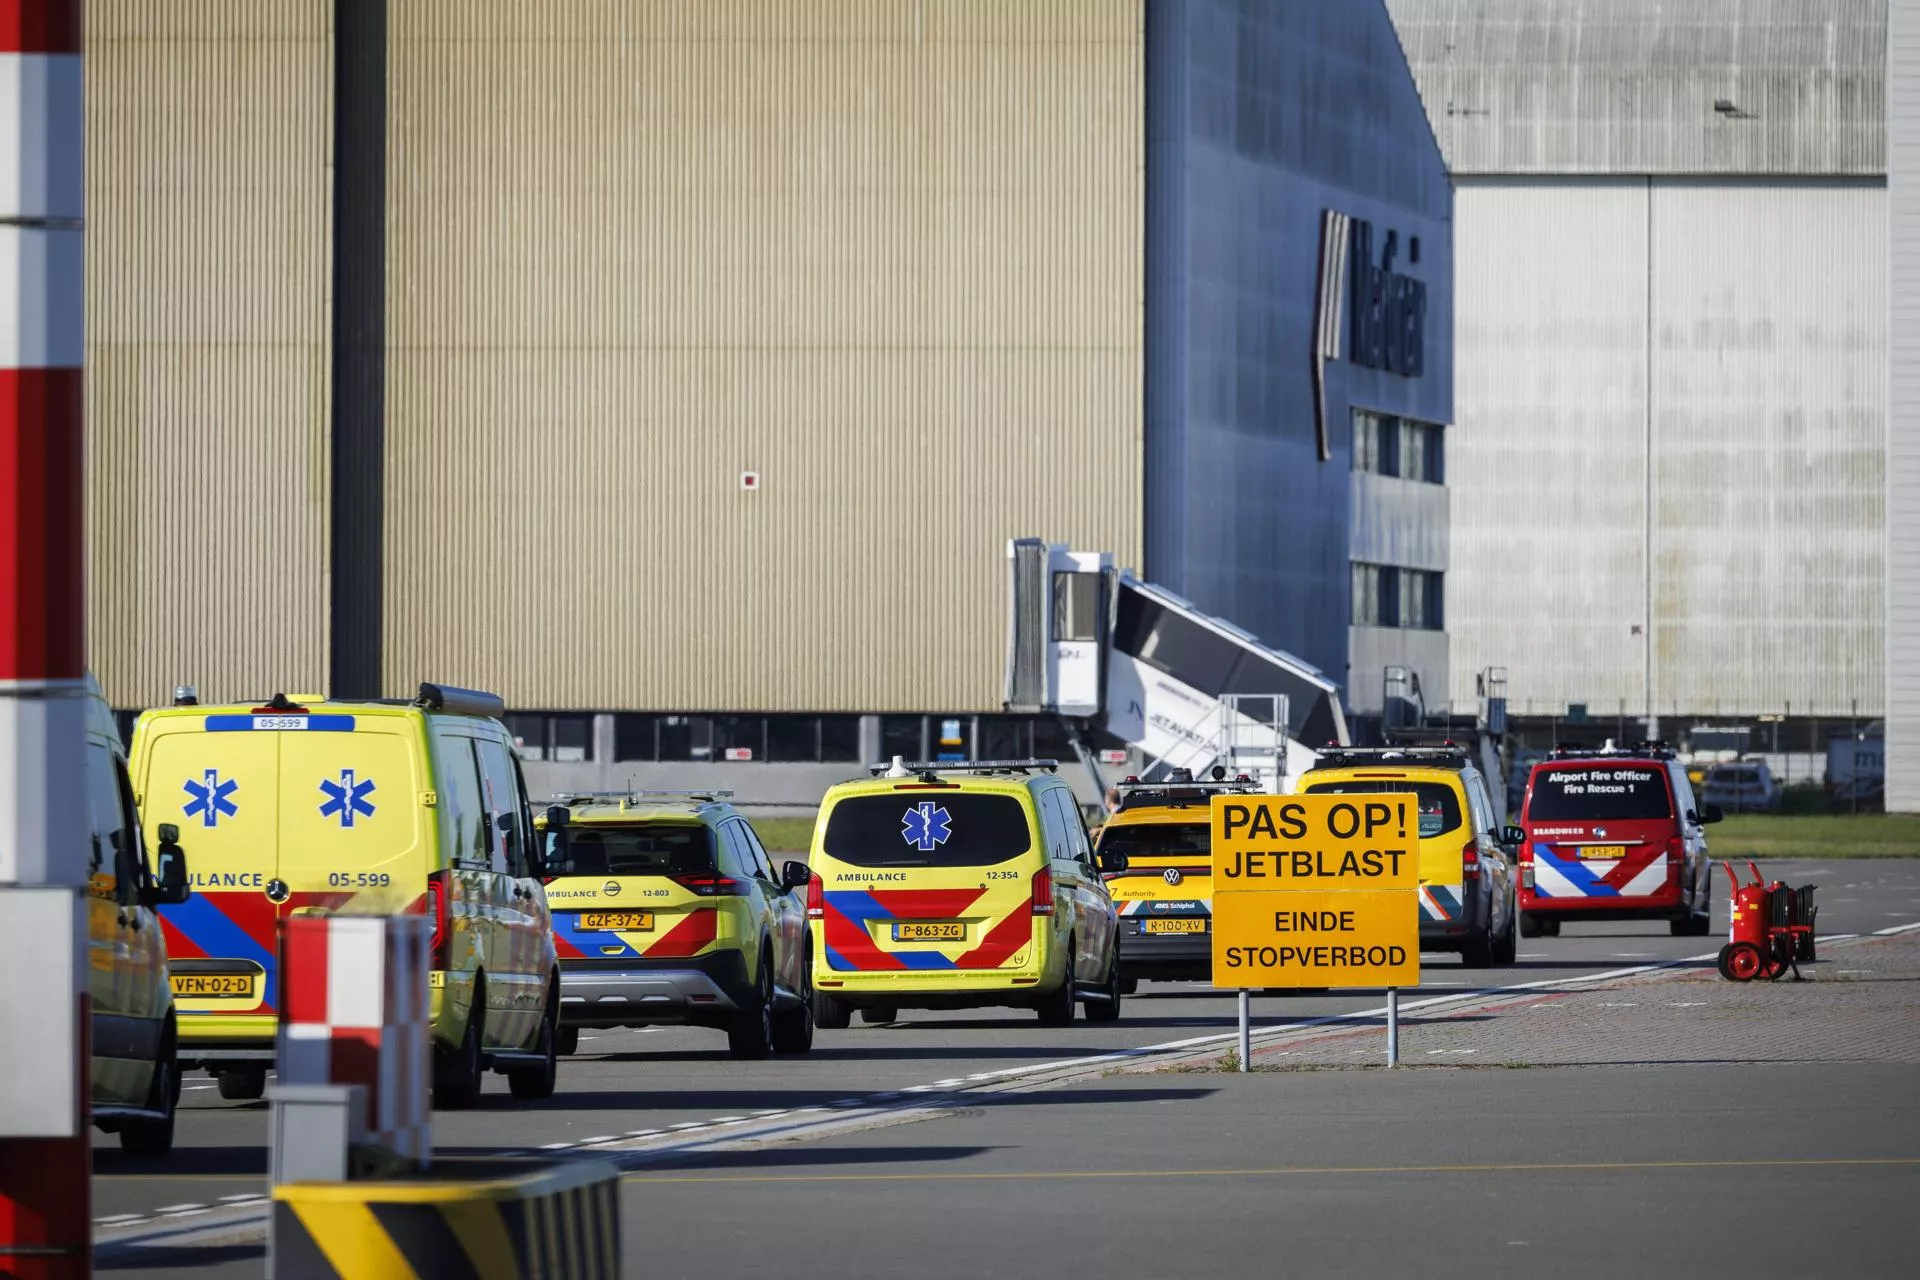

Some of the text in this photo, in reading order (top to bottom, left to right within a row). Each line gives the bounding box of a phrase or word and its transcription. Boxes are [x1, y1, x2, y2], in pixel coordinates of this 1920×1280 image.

[261, 719, 301, 728] 05-599
[1548, 770, 1651, 784] Airport Fire Officer
[1564, 784, 1634, 794] Fire Rescue 1
[1224, 803, 1406, 840] PAS OP!
[1224, 850, 1406, 878] JETBLAST
[329, 872, 390, 887] 05-599
[836, 873, 907, 882] AMBULANCE
[986, 872, 1018, 880] 12-354
[547, 890, 597, 898] MBULANCE
[1123, 890, 1156, 898] Authority
[1170, 902, 1195, 910] Schiphol
[587, 914, 645, 927] GZF-37-Z
[1151, 920, 1200, 931] R-100-XV
[1275, 911, 1355, 932] EINDE
[903, 925, 959, 937] P-863-ZG
[1226, 946, 1406, 968] STOPVERBOD
[175, 978, 248, 992] VFN-02-D
